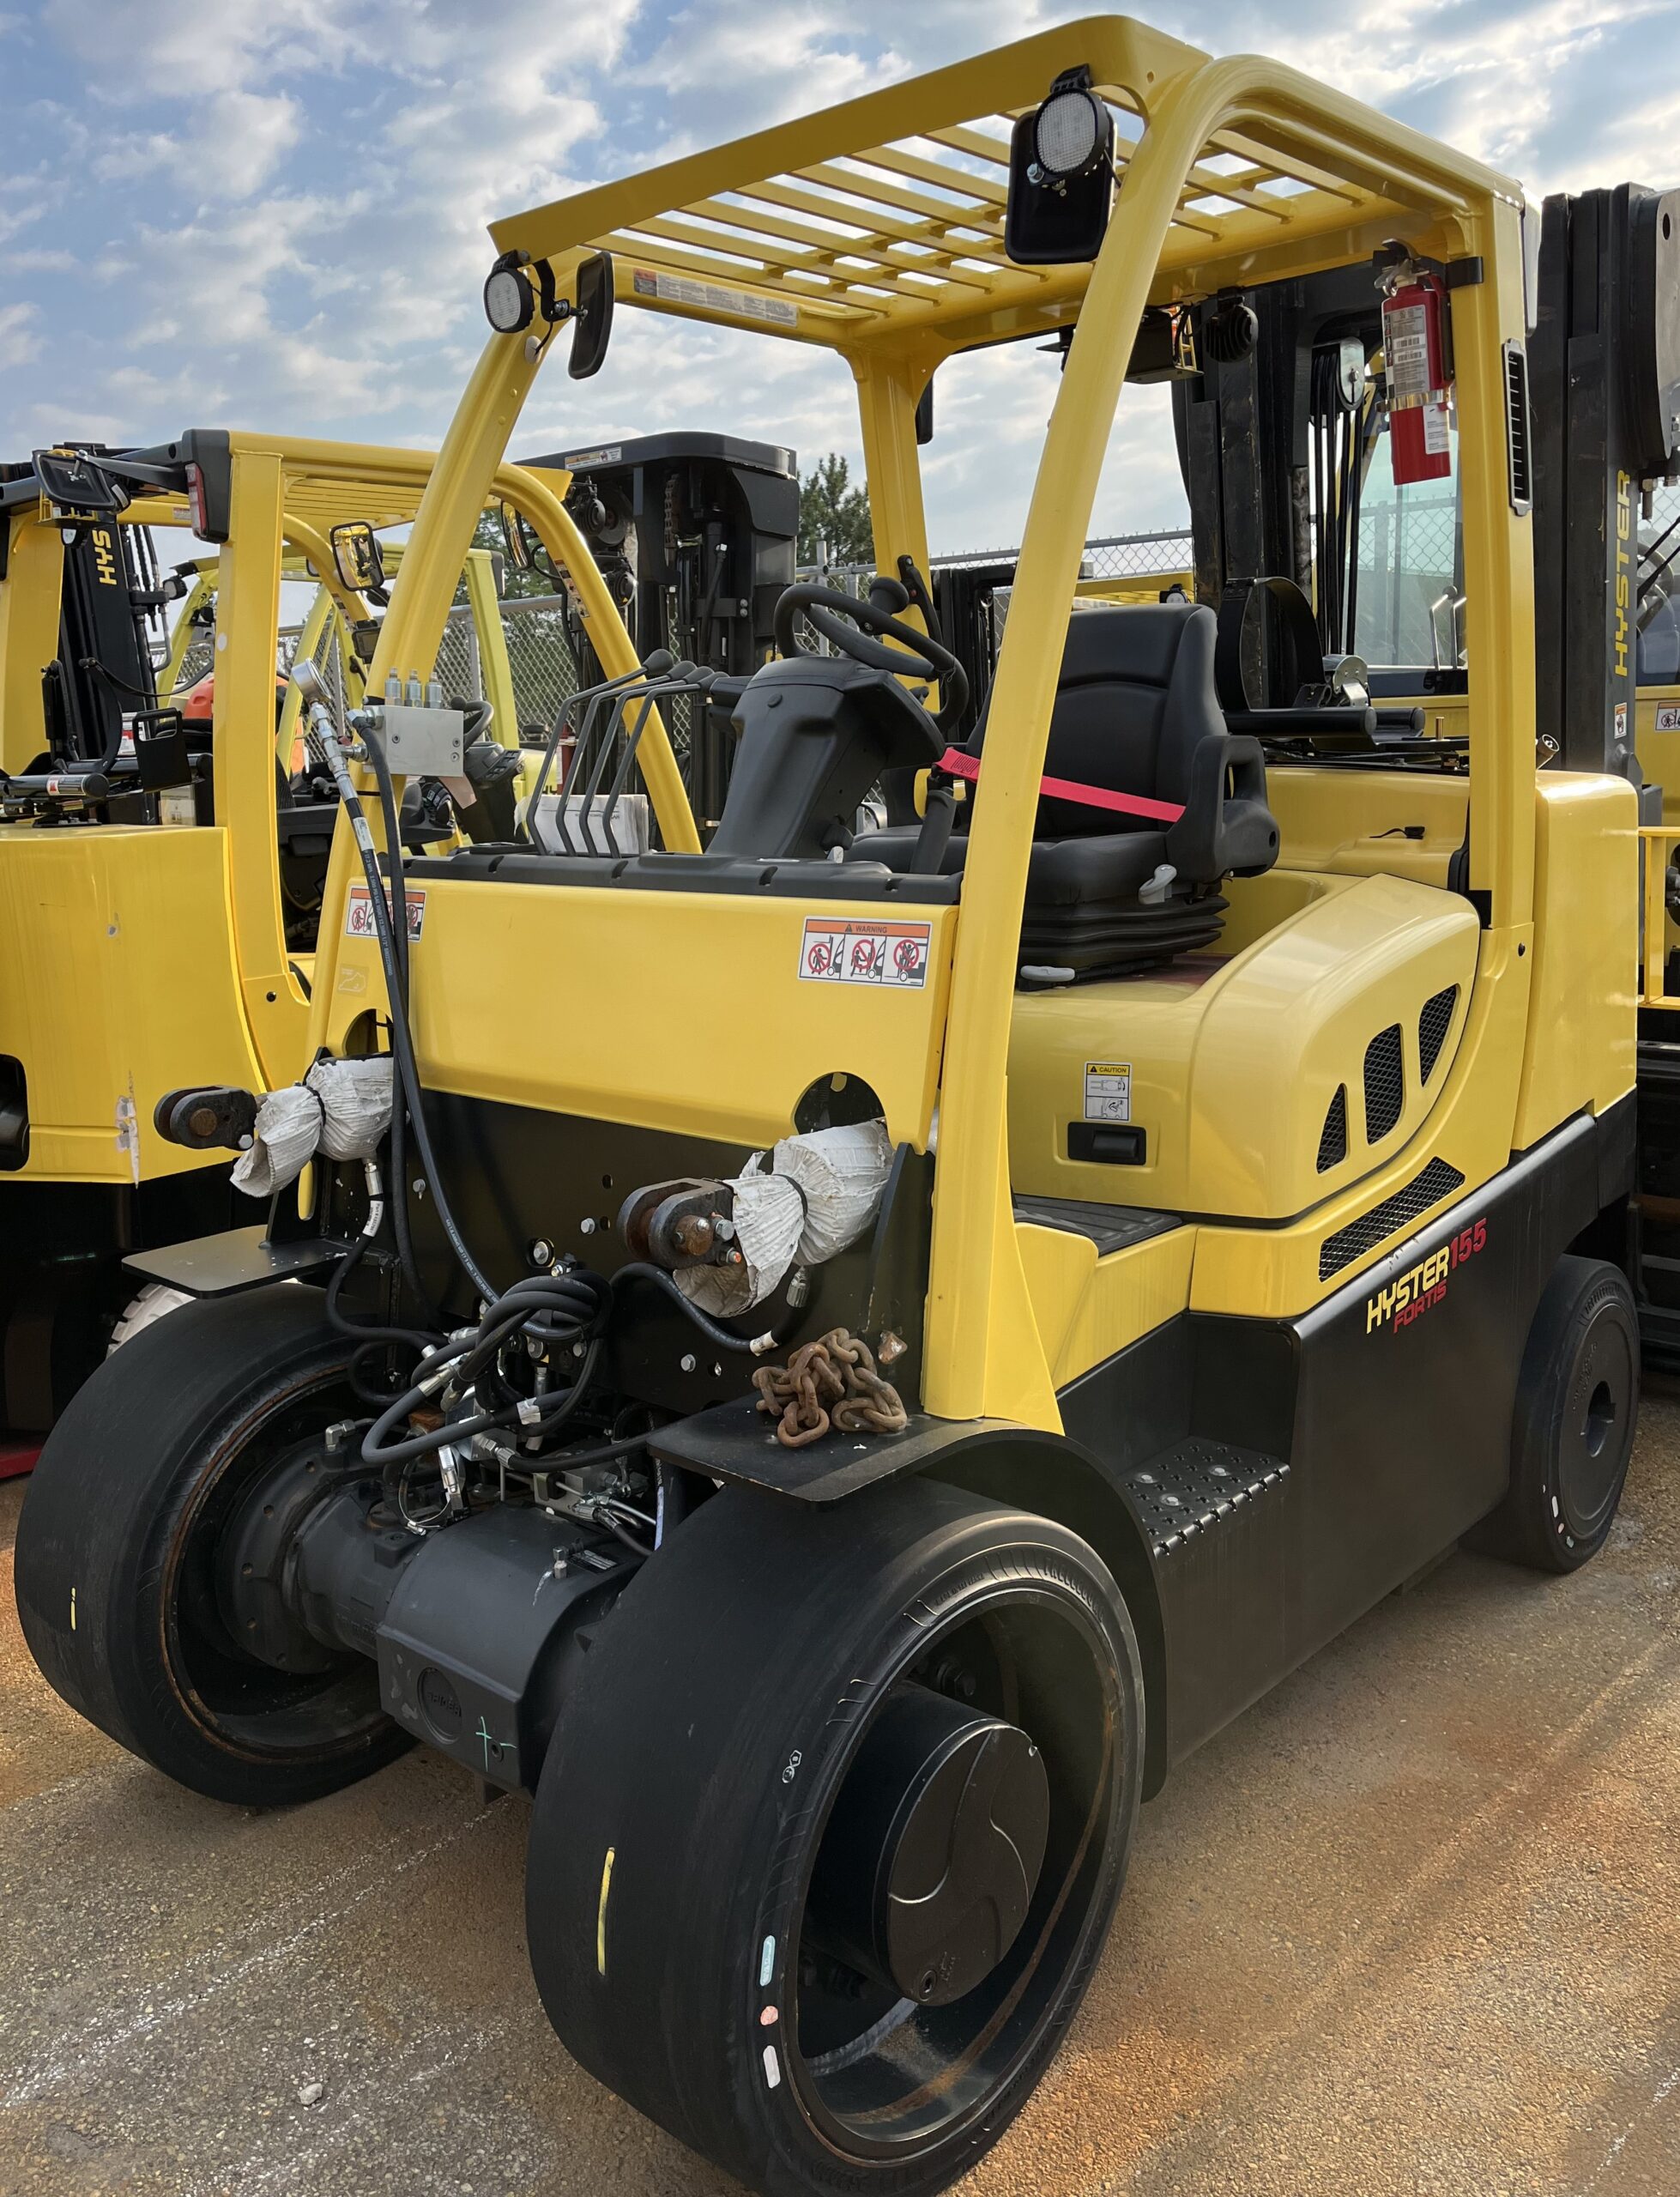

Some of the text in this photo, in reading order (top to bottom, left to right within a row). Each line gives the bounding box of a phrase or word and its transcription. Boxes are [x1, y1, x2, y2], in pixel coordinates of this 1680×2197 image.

[1614, 469, 1630, 676] HYSTER
[1366, 1217, 1487, 1335] HYSTER 155
[1393, 1279, 1447, 1334] FORTIS
